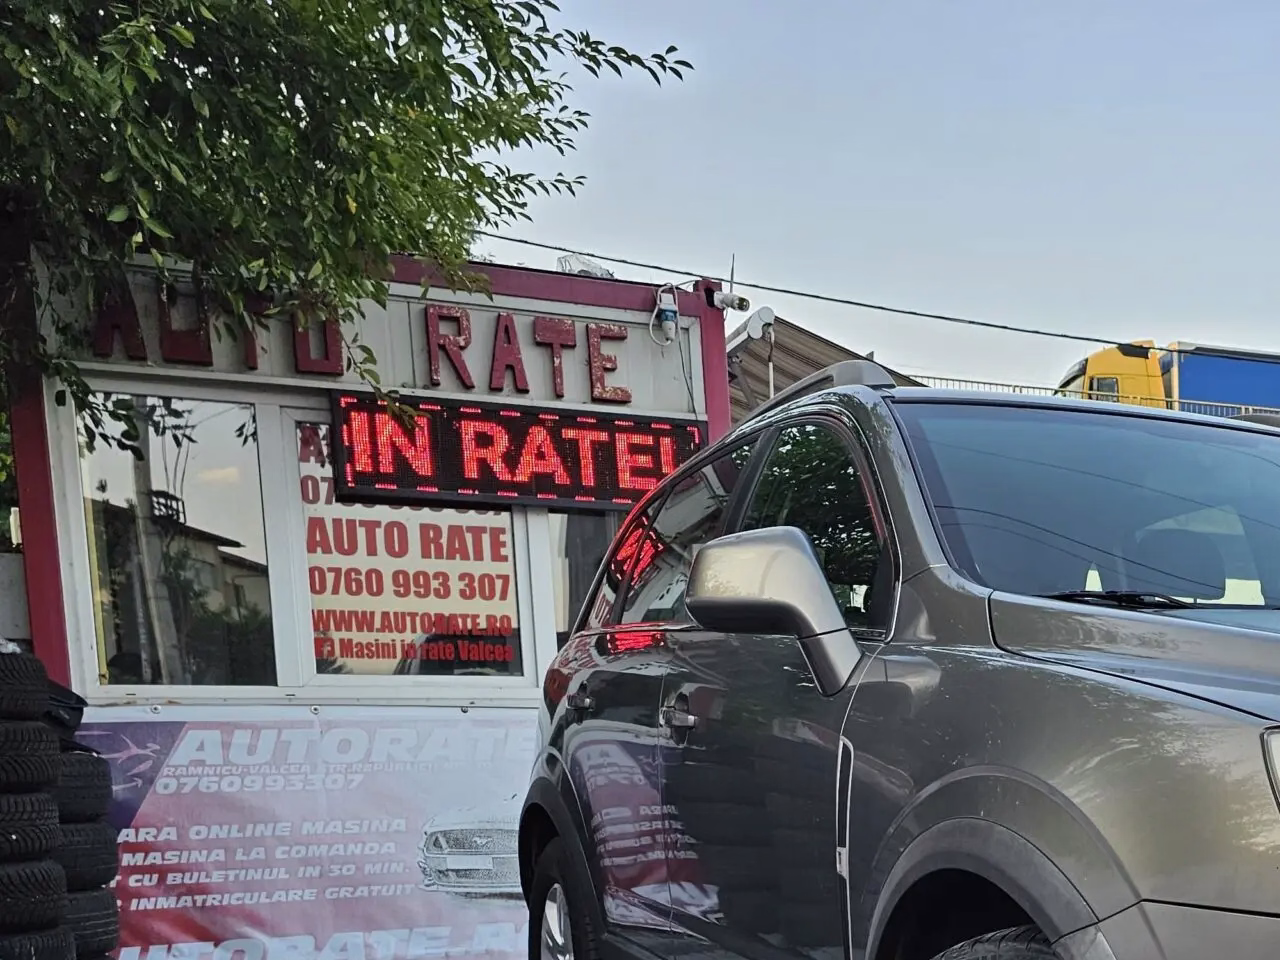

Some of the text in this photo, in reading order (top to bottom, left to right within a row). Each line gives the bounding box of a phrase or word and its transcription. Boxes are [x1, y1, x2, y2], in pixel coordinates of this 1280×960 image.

[425, 304, 632, 403] RATE
[351, 410, 434, 476] IN
[306, 516, 509, 562] AUTO RATE
[308, 566, 511, 601] 0760 993 307
[312, 609, 513, 637] WWW.AUTORATE.RO
[339, 638, 397, 659] Masini
[421, 640, 455, 660] rate
[457, 640, 513, 661] Valcea
[169, 726, 538, 766] AUTORATE
[155, 773, 364, 795] 0760993307
[189, 822, 292, 841] ONLINE
[301, 818, 407, 836] MASINA
[121, 841, 397, 866] MASINA LA COMANDA
[128, 873, 159, 887] CU
[166, 867, 290, 885] BULETINUL
[297, 864, 322, 878] IN
[328, 863, 356, 877] 30
[363, 860, 410, 876] MIN.
[130, 888, 318, 911] INMATRICULARE
[324, 883, 416, 900] GRATUIT
